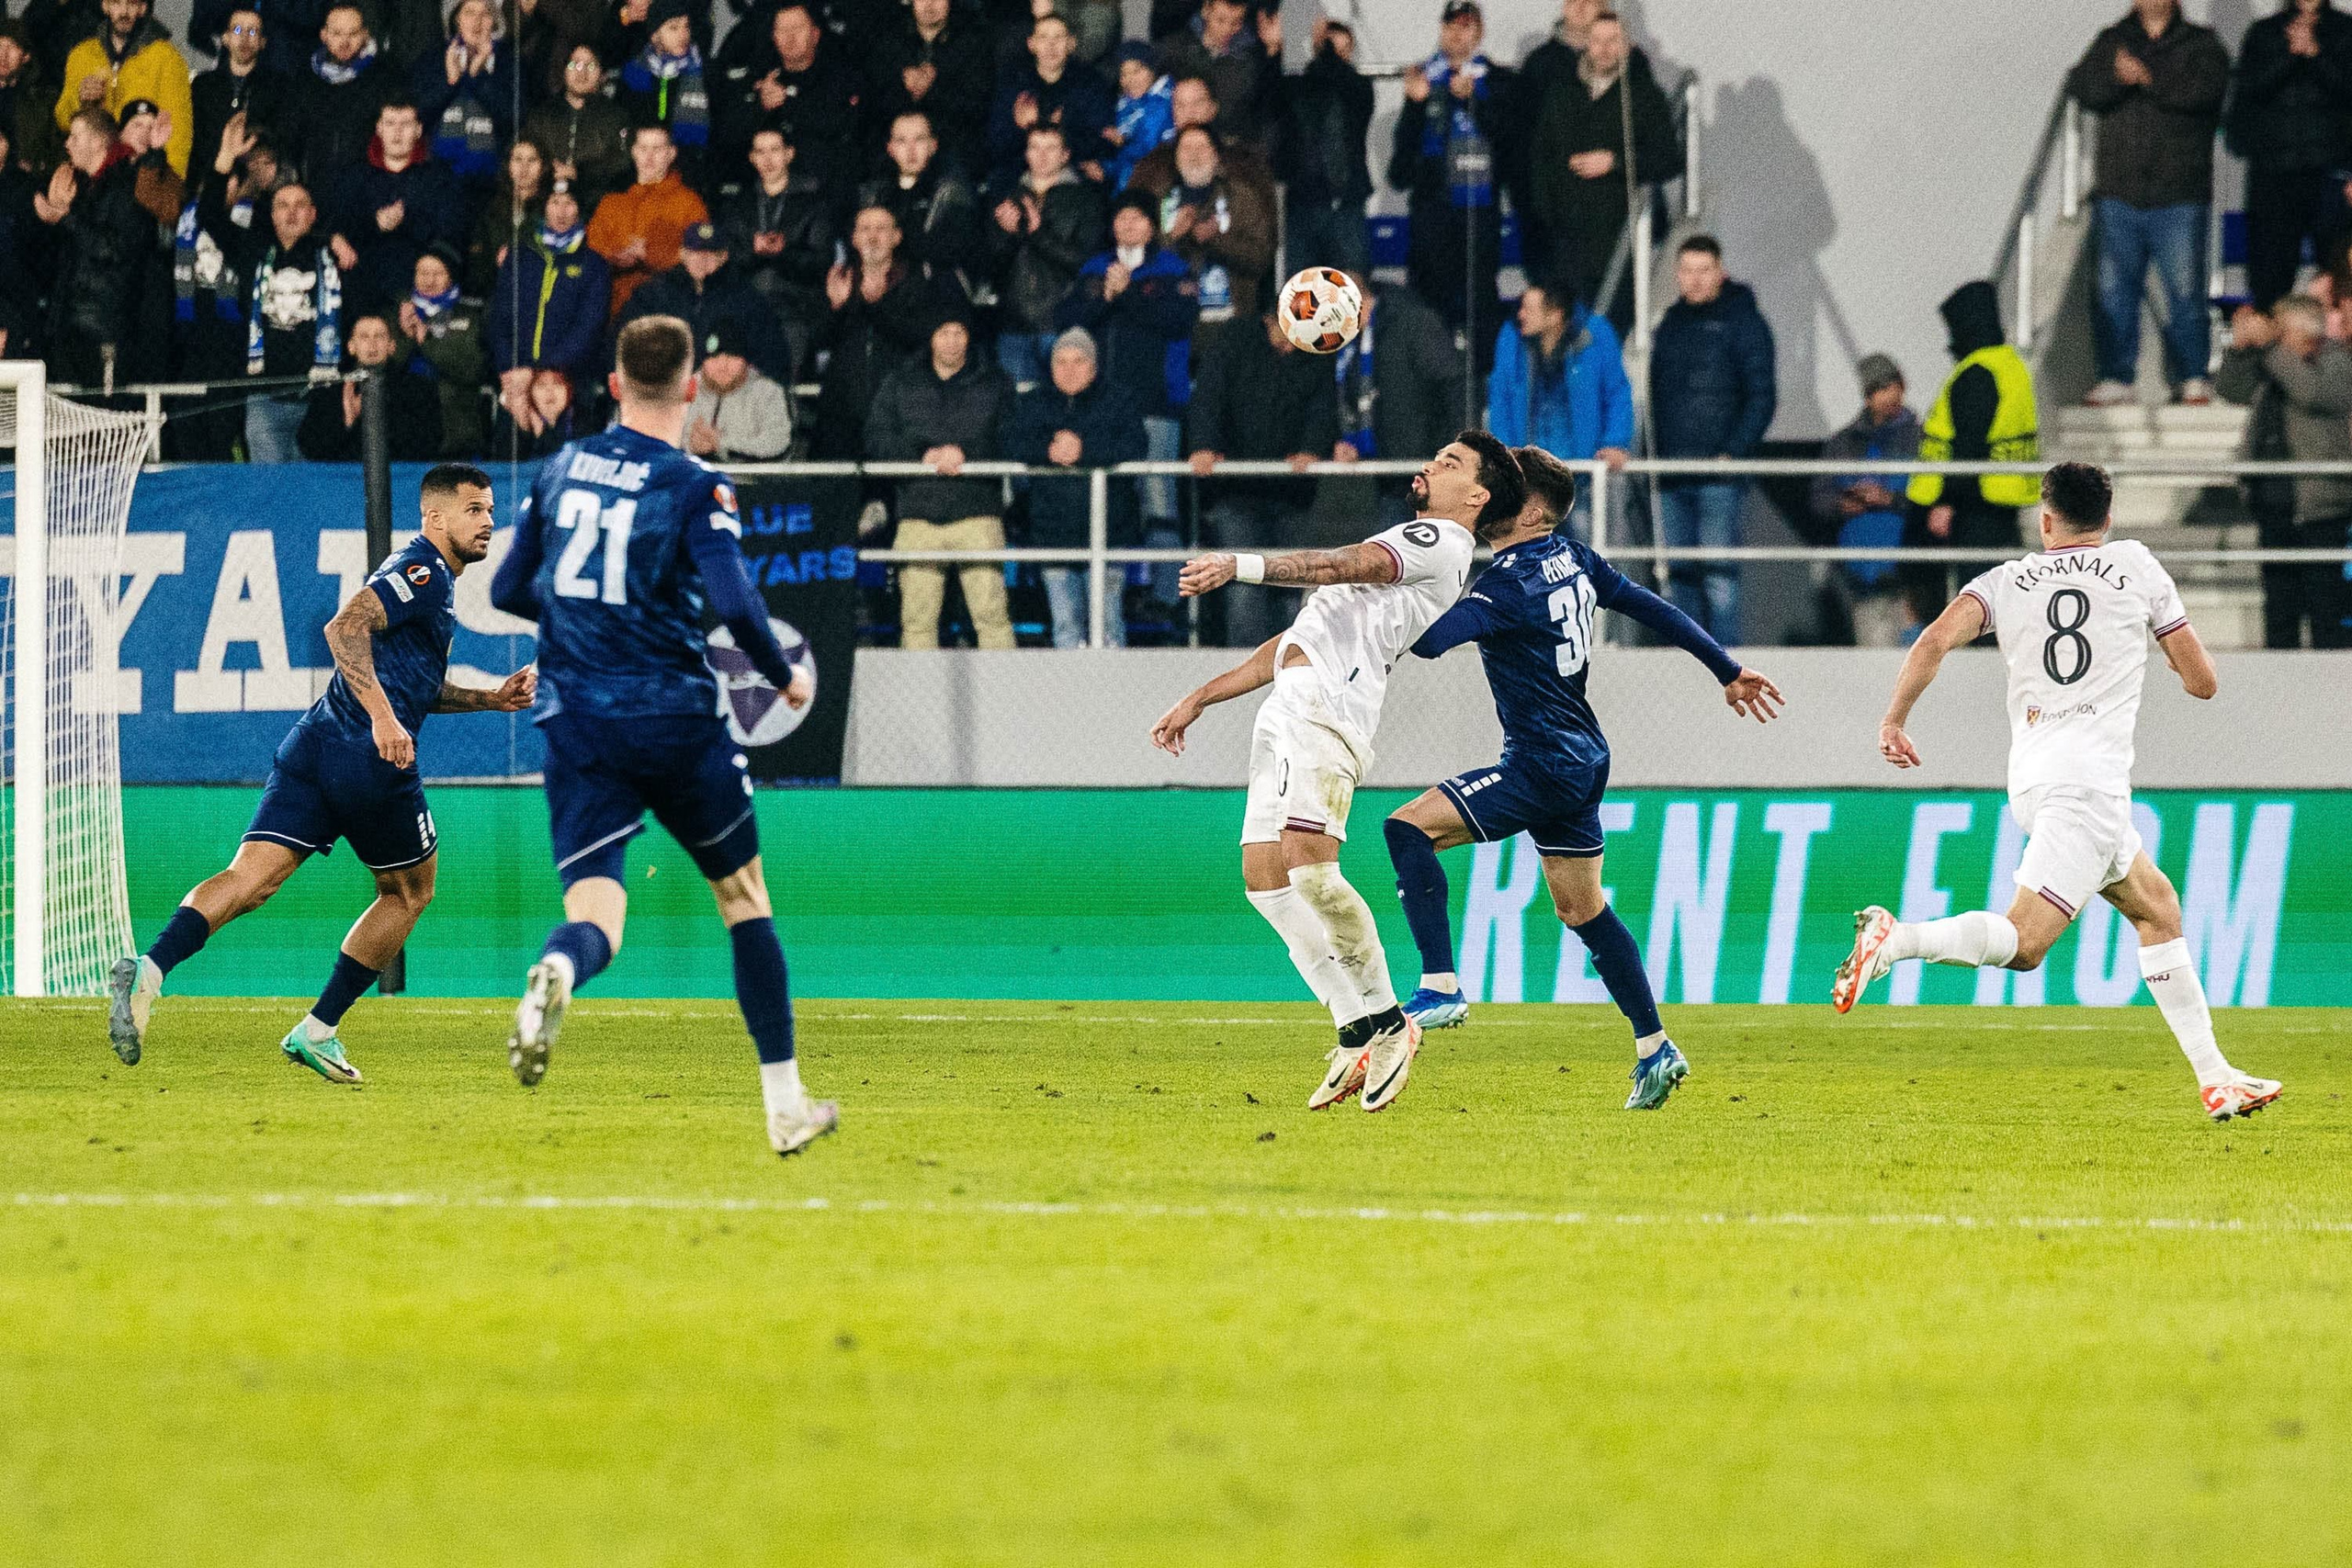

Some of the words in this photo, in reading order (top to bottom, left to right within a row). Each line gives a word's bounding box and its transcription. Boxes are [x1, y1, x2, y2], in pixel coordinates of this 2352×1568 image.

[553, 489, 638, 605] 21
[1547, 573, 1598, 677] 30
[2043, 589, 2092, 685] 8
